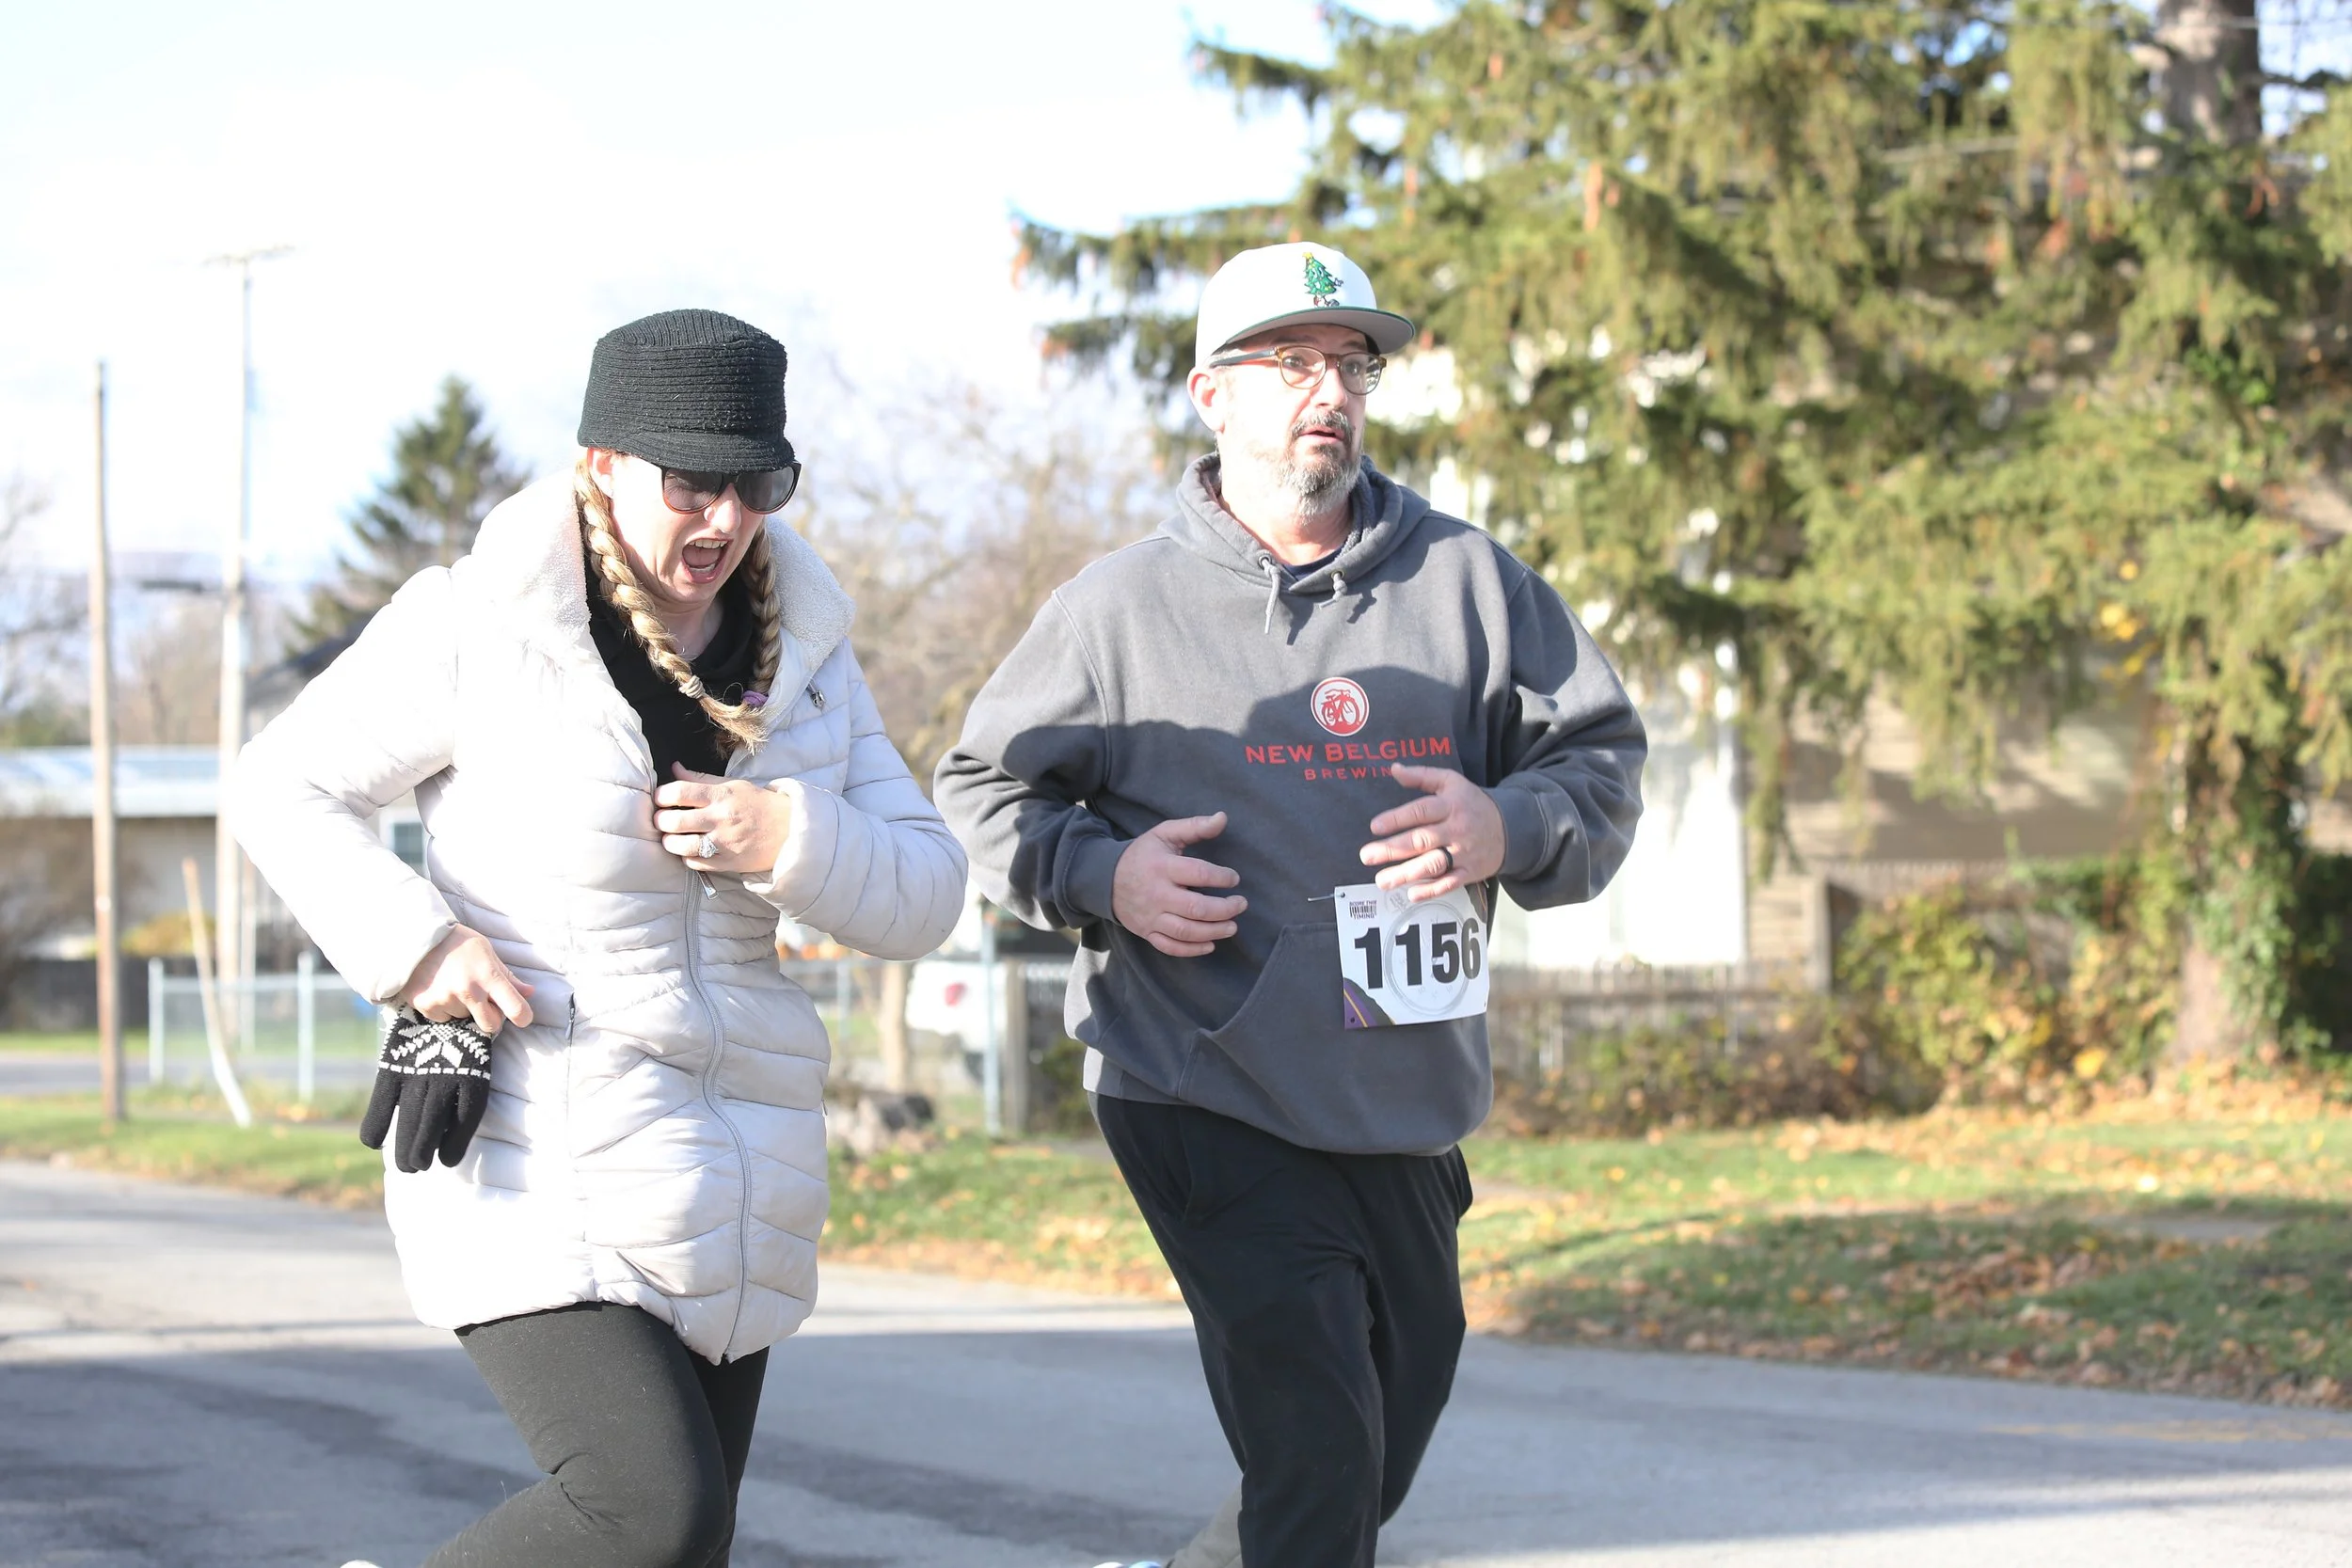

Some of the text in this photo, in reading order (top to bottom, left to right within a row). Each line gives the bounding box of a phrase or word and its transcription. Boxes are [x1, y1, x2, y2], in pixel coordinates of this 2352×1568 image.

[1245, 736, 1451, 764] NEW BELGIUM
[1304, 766, 1392, 781] BREWIN
[1354, 917, 1482, 990] 1156
